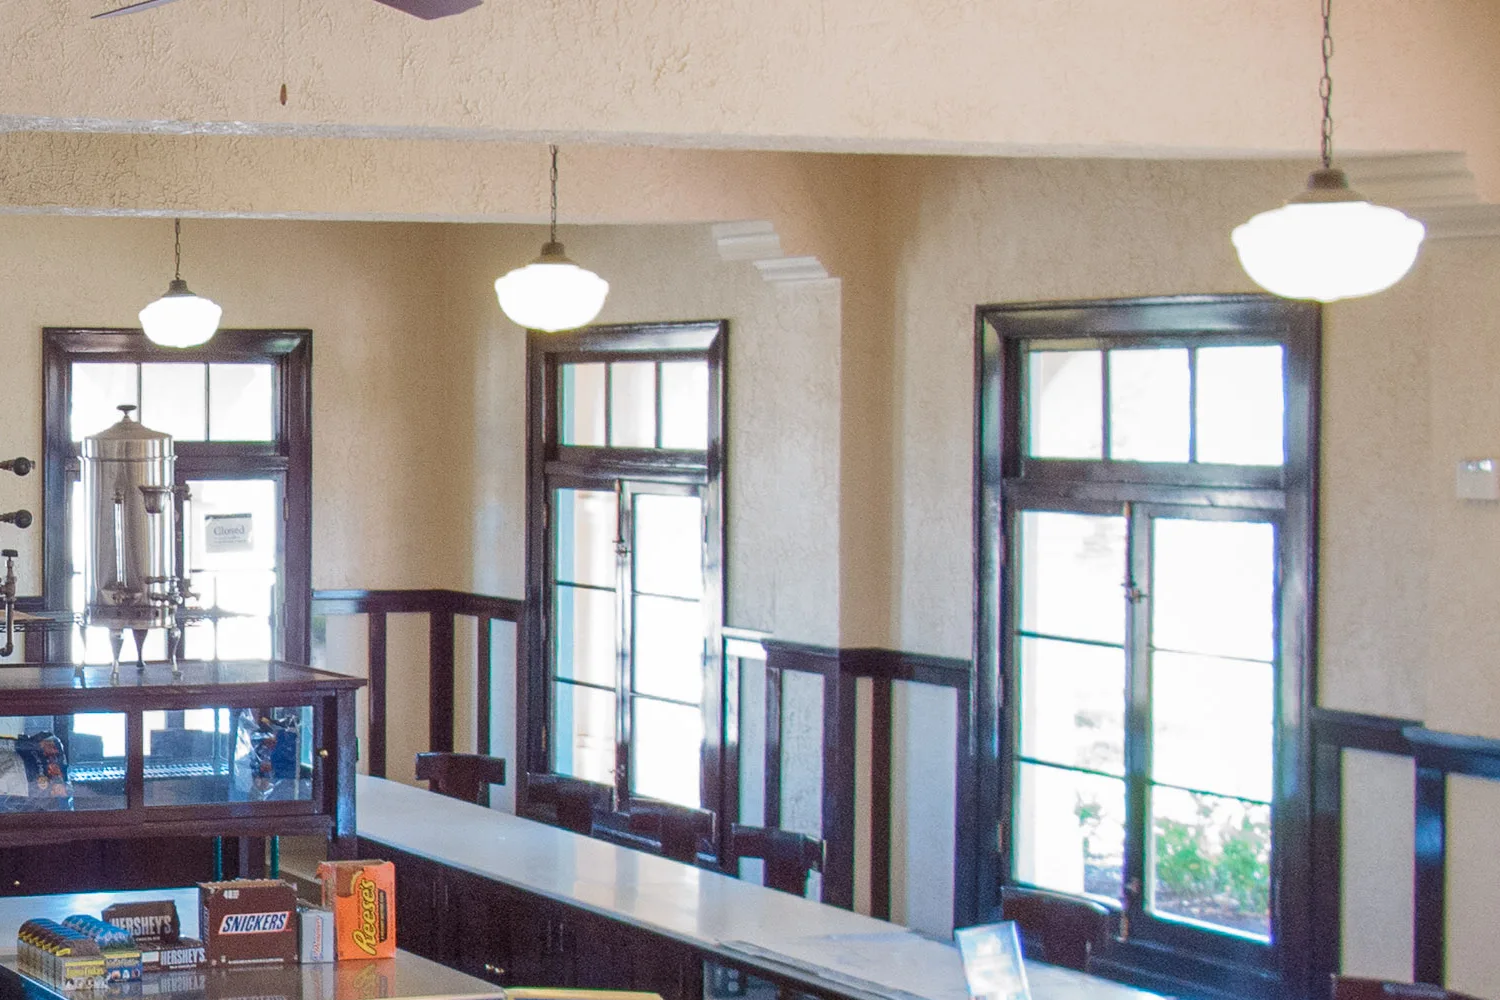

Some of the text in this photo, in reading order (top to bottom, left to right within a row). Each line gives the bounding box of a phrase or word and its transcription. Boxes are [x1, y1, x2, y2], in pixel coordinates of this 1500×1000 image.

[213, 524, 246, 536] Closed
[222, 913, 287, 933] SNICKERS
[160, 948, 206, 966] HERSHEY'S
